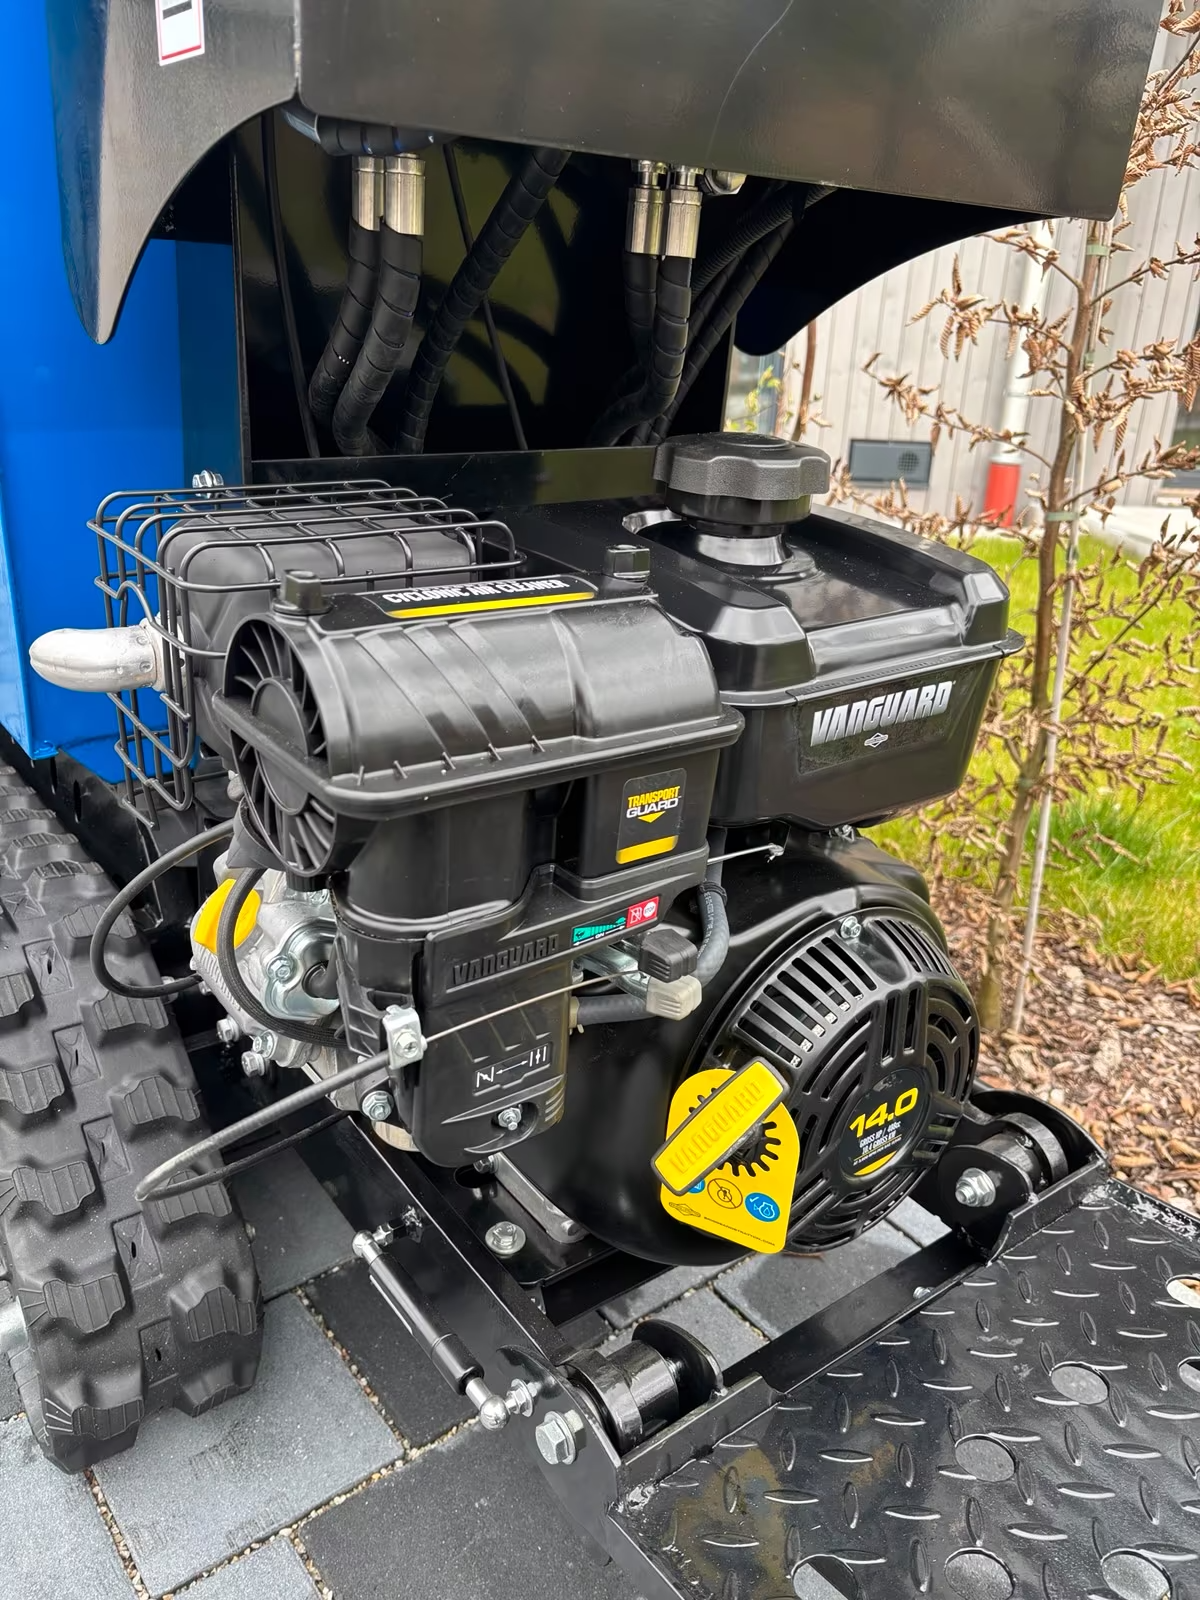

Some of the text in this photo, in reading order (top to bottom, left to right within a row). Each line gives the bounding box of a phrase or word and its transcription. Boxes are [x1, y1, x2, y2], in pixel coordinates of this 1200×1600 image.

[382, 588, 470, 603] CYCLONIC
[469, 583, 497, 596] AIR
[496, 579, 570, 594] CLEANER
[810, 681, 953, 747] VANGUARD
[626, 798, 679, 818] GUARD
[627, 785, 681, 809] TRANSPORT
[453, 933, 559, 985] VANGUARD
[669, 1081, 764, 1174] VANGUARD
[849, 1087, 918, 1138] 14.0
